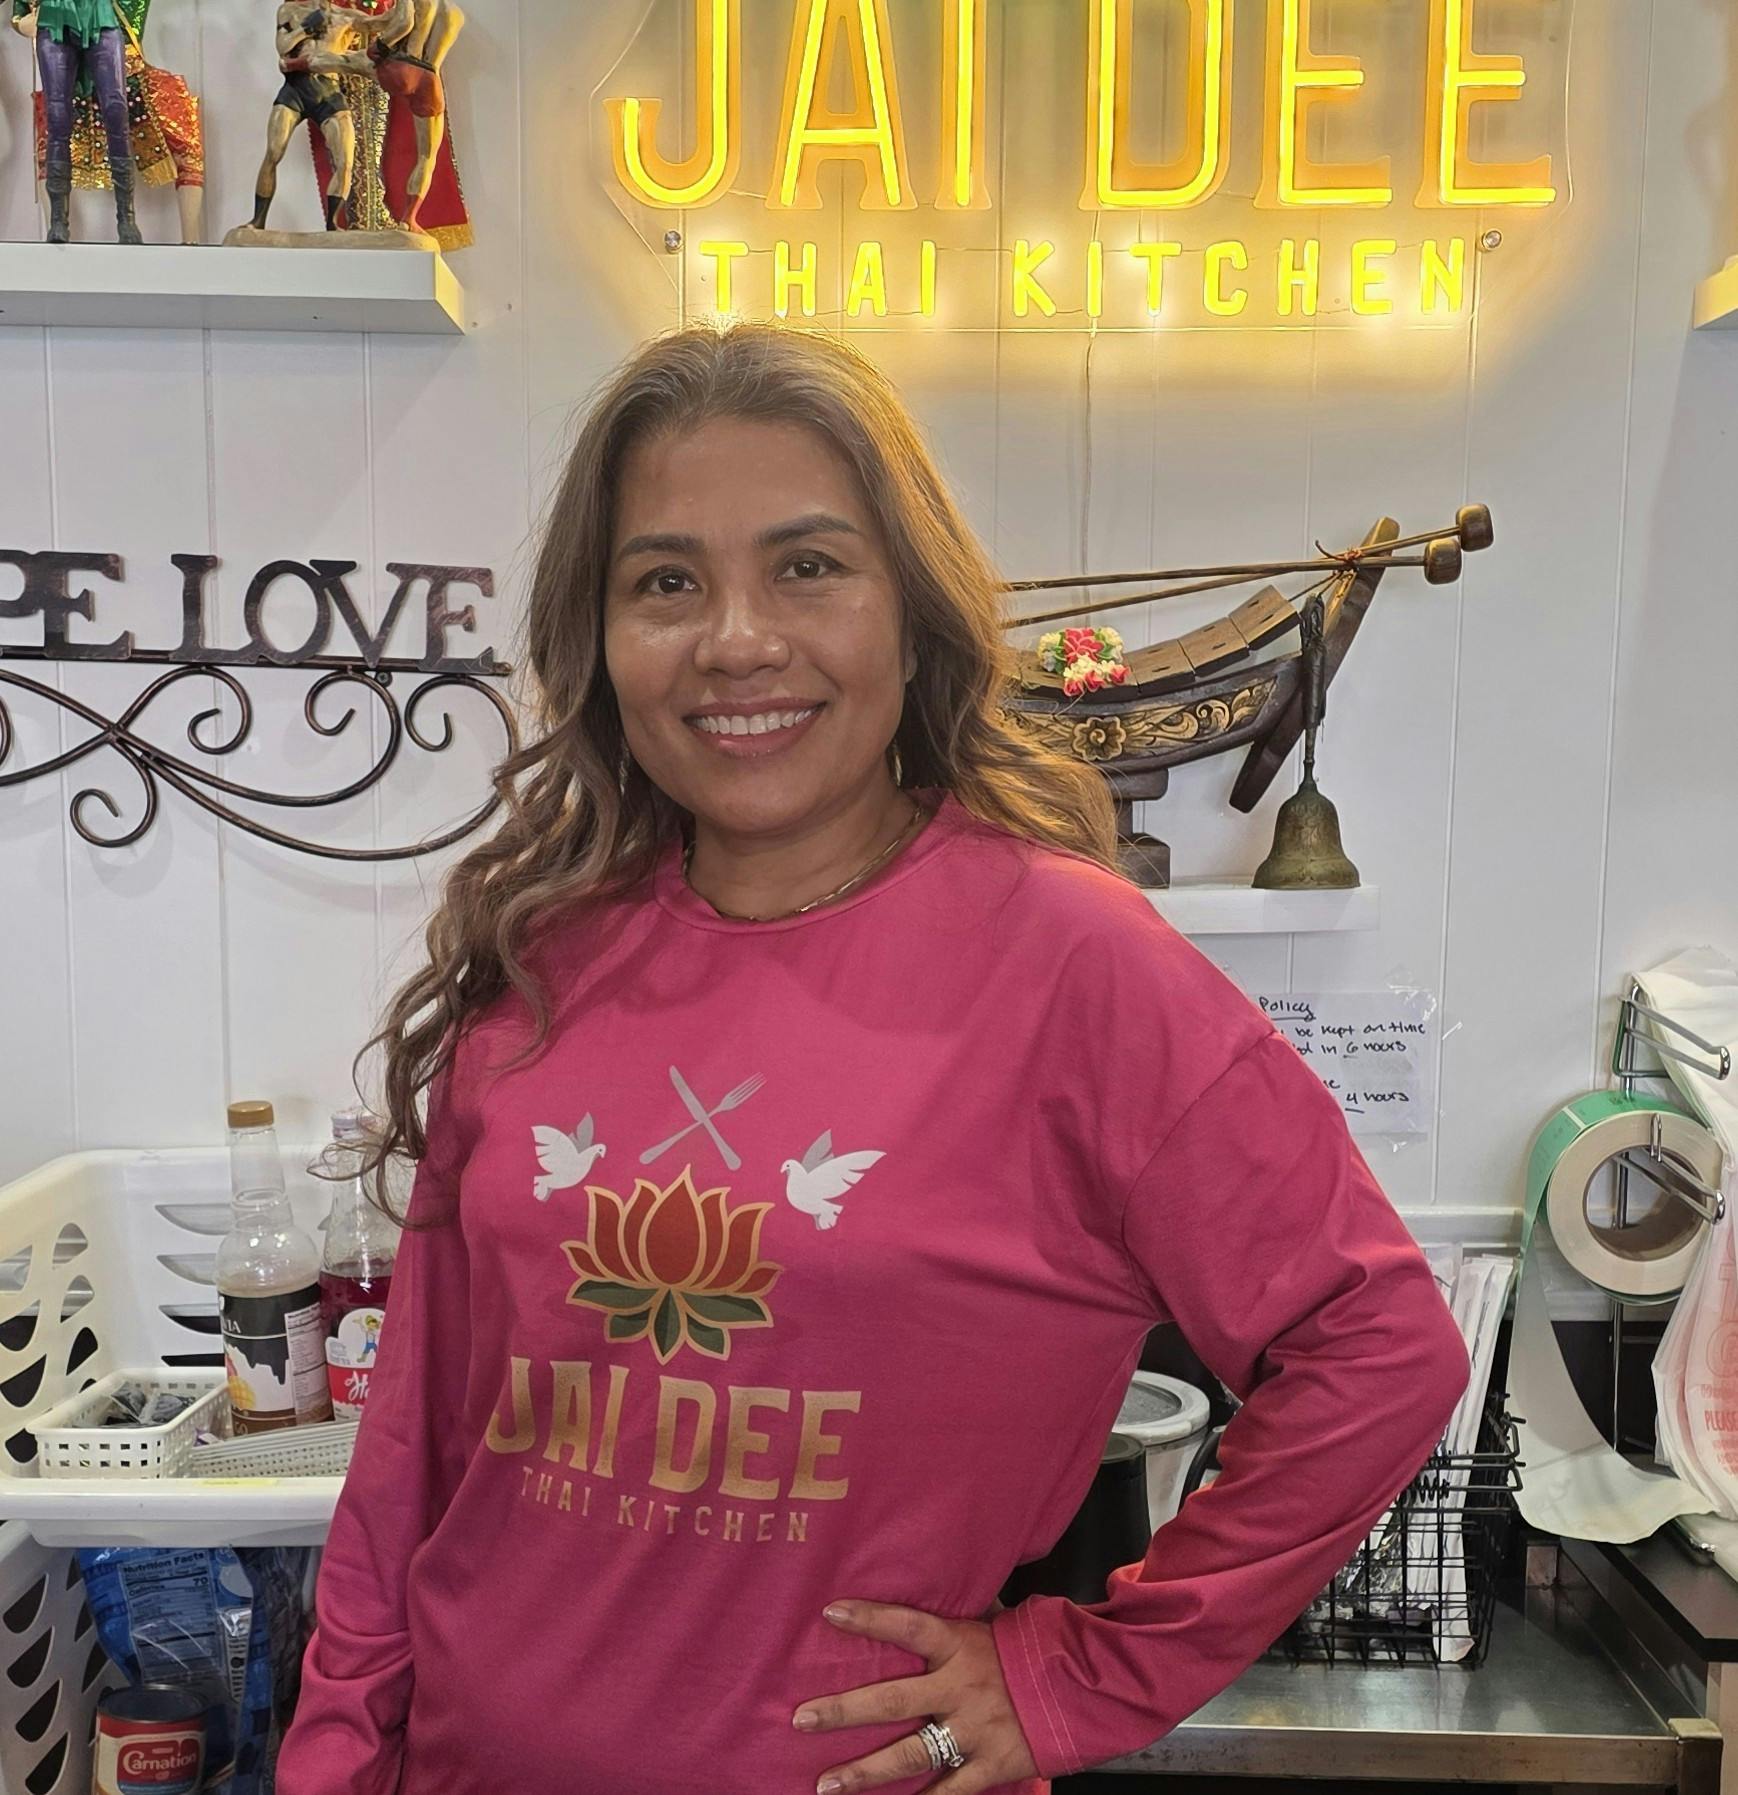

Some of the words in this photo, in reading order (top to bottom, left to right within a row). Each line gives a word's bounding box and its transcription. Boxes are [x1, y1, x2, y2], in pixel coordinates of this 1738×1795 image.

[605, 0, 991, 209] JAI
[1078, 0, 1557, 209] DEE
[698, 239, 937, 318] THAI
[1012, 238, 1466, 318] KITCHEN
[168, 554, 495, 672] LOVE
[1295, 1026, 1313, 1037] be
[1321, 1025, 1355, 1038] kept
[1388, 1021, 1426, 1035] time
[1346, 1041, 1359, 1054] 6
[1363, 1041, 1406, 1052] hours
[1346, 1092, 1358, 1105] 4
[1363, 1092, 1409, 1102] hours
[486, 1356, 630, 1479] JAI
[648, 1375, 862, 1500] DEE
[521, 1466, 591, 1516] THAI
[617, 1495, 808, 1542] KITCHEN
[174, 1552, 204, 1566] Facts
[193, 1577, 209, 1587] 70
[123, 1750, 197, 1775] Carnation
